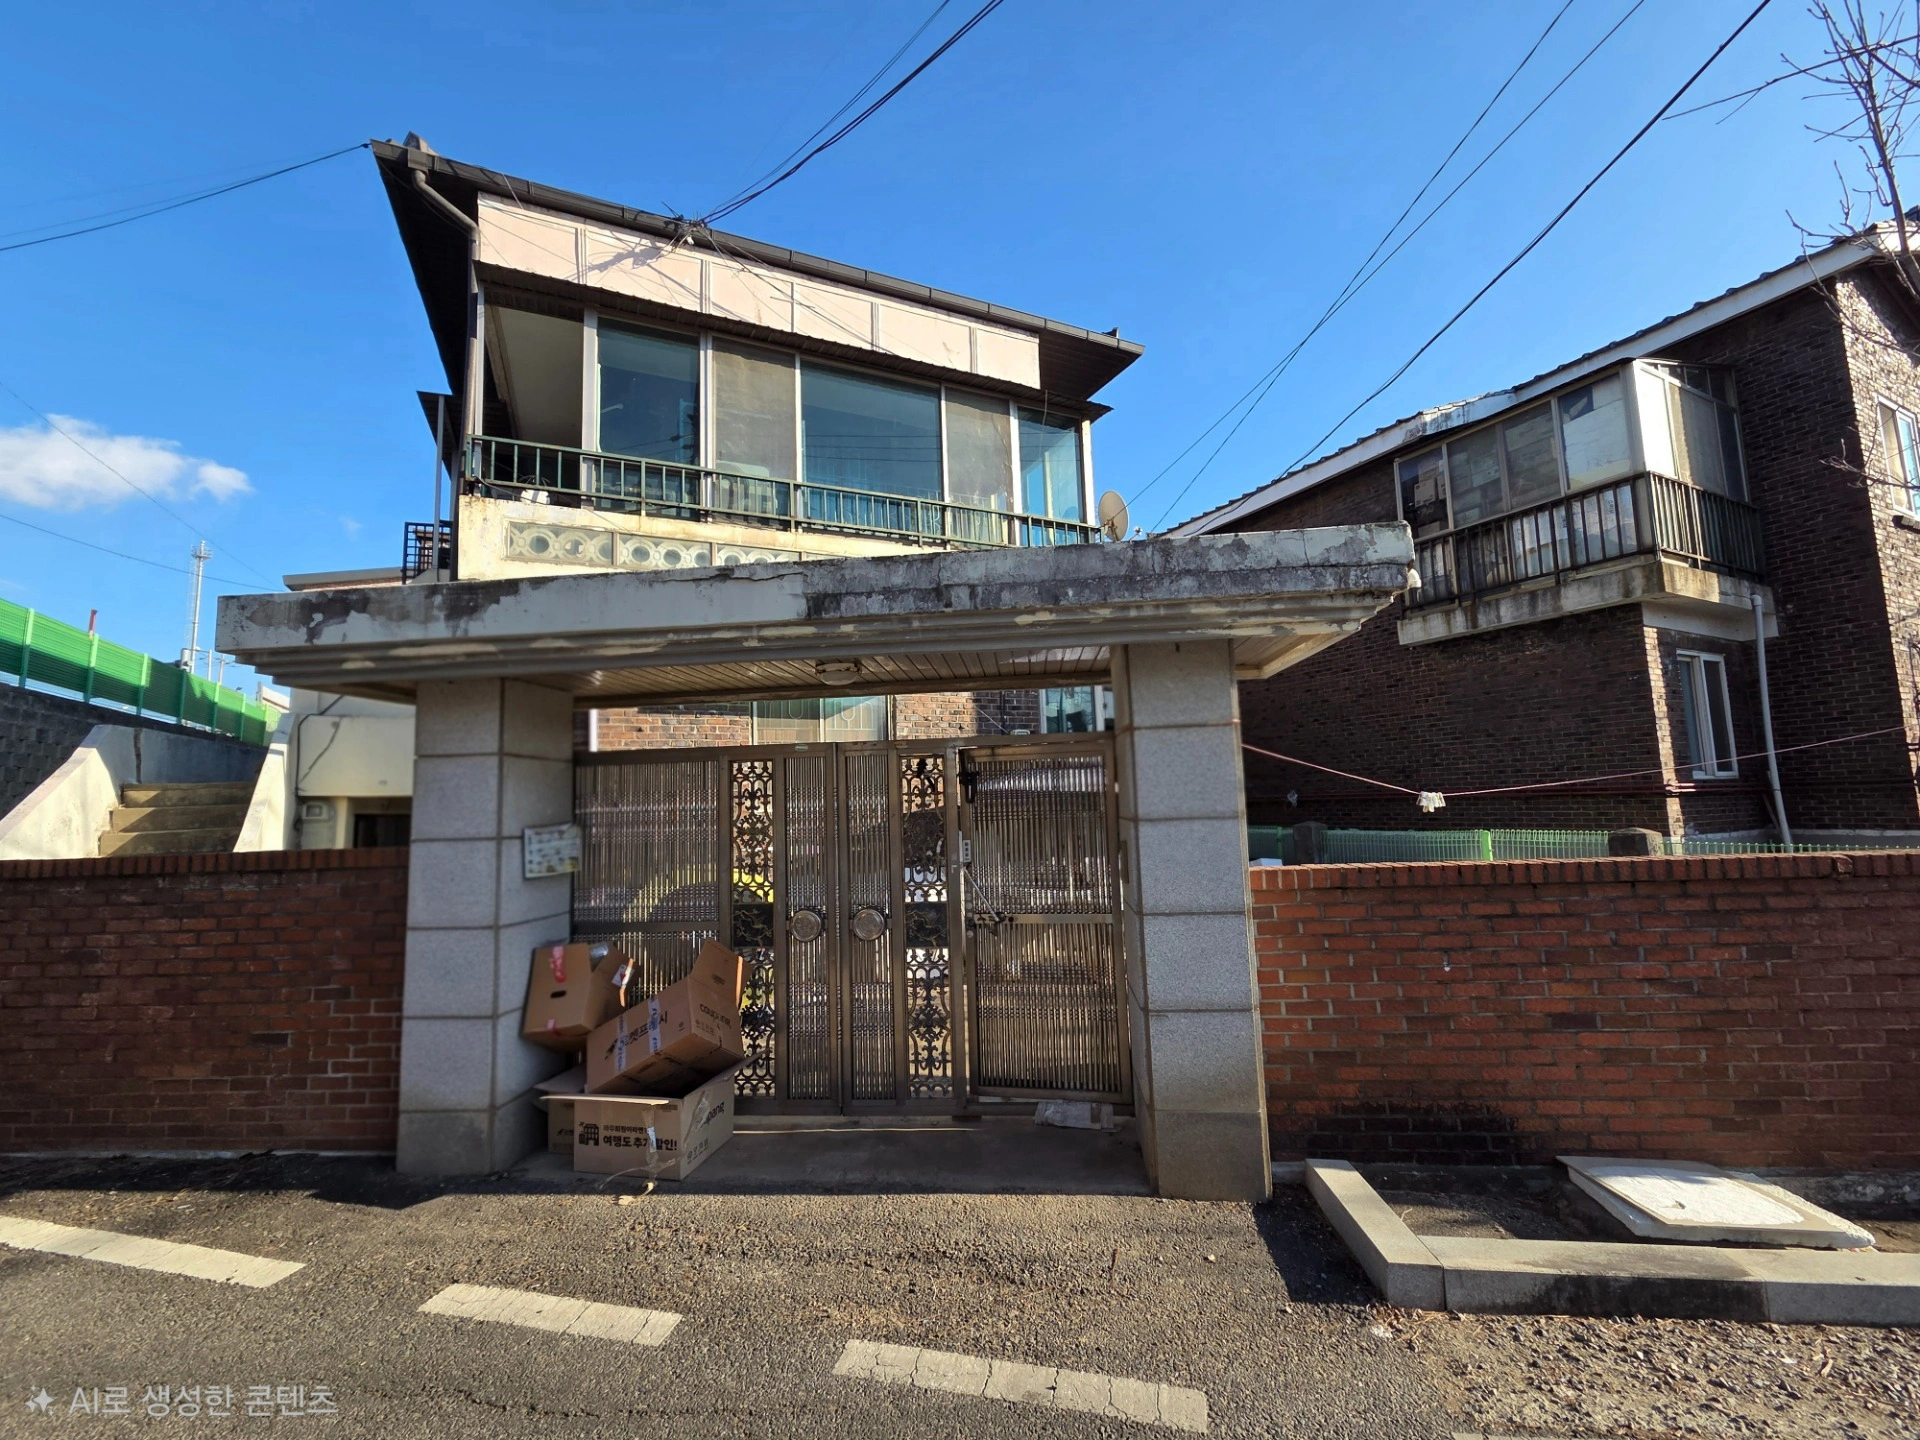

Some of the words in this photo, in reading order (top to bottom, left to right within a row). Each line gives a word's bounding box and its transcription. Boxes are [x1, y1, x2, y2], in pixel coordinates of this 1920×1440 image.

[620, 1011, 667, 1046] 로켓프시
[694, 1101, 725, 1127] pang
[603, 1135, 632, 1147] 여행도
